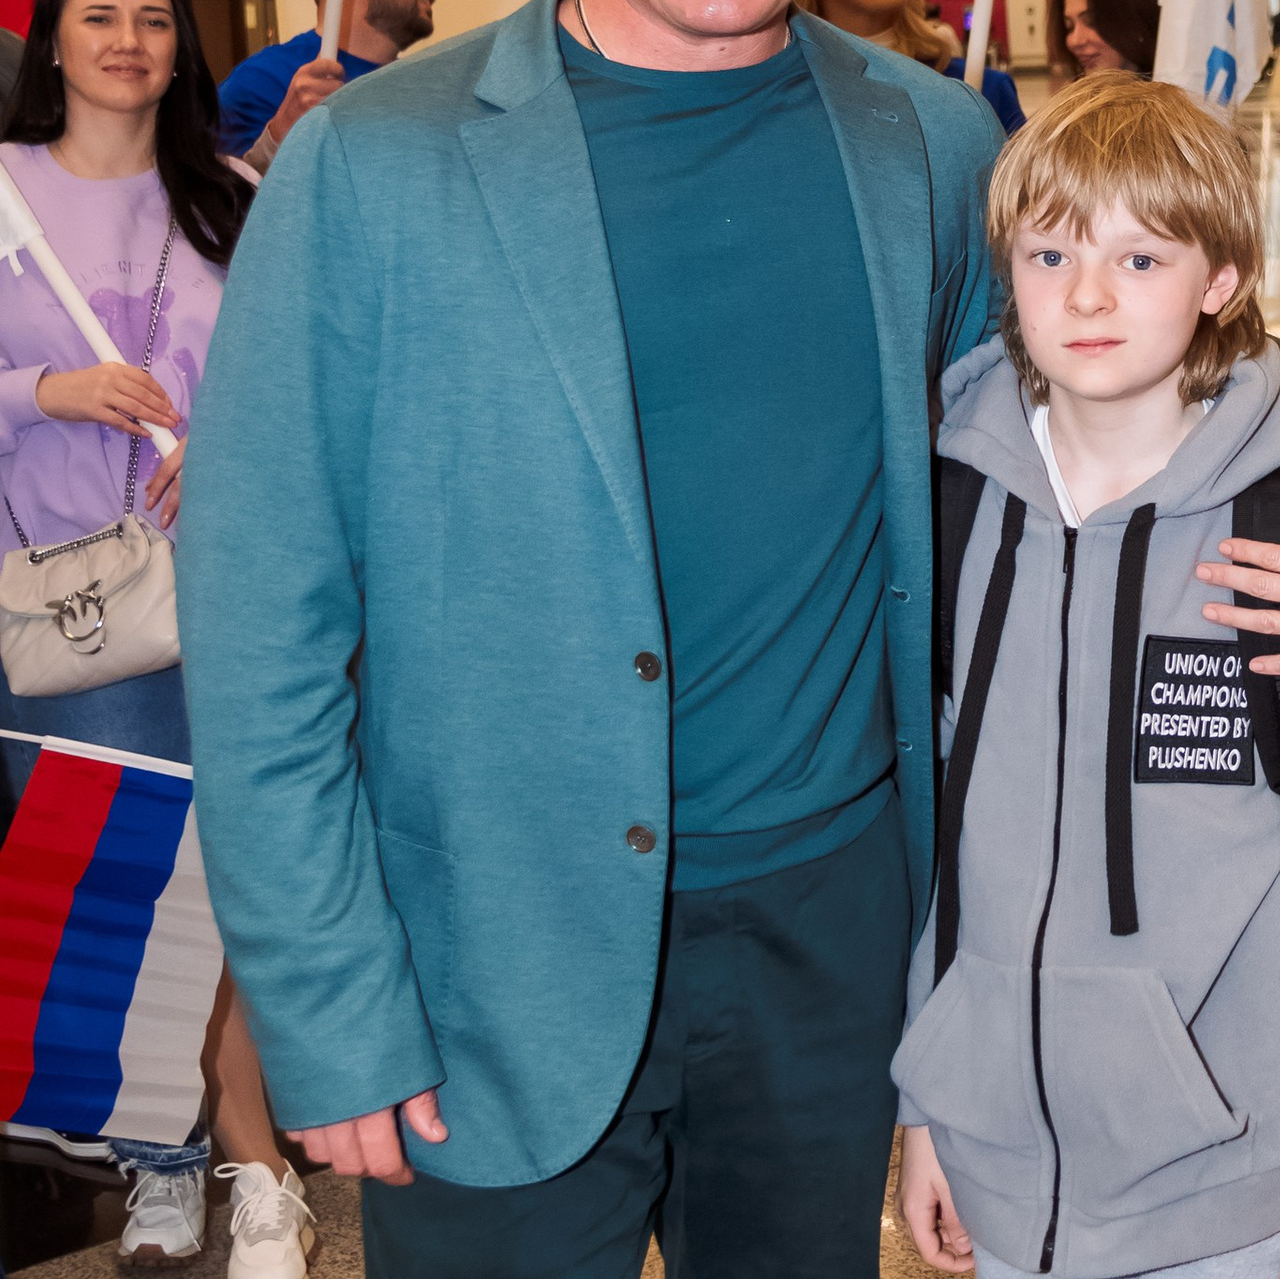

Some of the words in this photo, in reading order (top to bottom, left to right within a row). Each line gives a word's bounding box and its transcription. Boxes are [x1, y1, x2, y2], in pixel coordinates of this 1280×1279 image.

[1165, 652, 1221, 677] UNION
[1150, 682, 1248, 708] CHAMPIONS
[1140, 713, 1231, 739] PRESENTED
[1232, 717, 1251, 739] BY
[1148, 746, 1241, 771] PLUSHENKO
